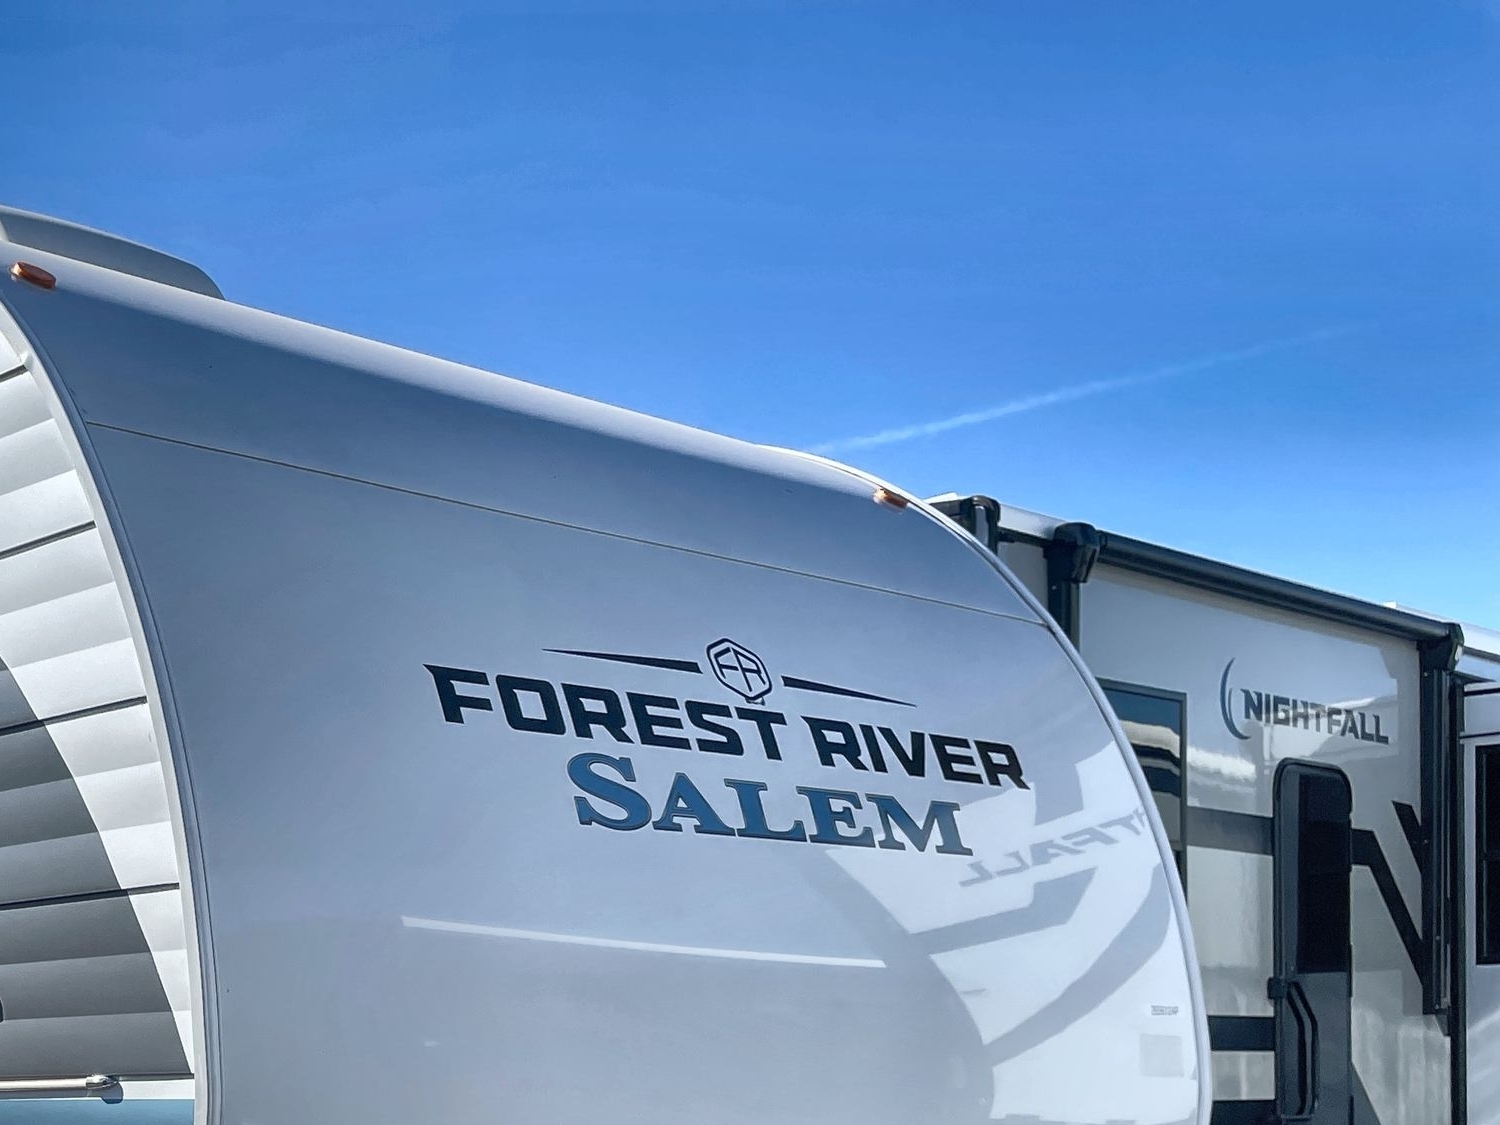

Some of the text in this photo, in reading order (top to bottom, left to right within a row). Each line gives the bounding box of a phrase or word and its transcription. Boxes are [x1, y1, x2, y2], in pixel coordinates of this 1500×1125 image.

[423, 662, 1031, 790] FOREST RIVER
[1239, 687, 1389, 745] NIGHTFALL
[566, 752, 974, 857] SALEM
